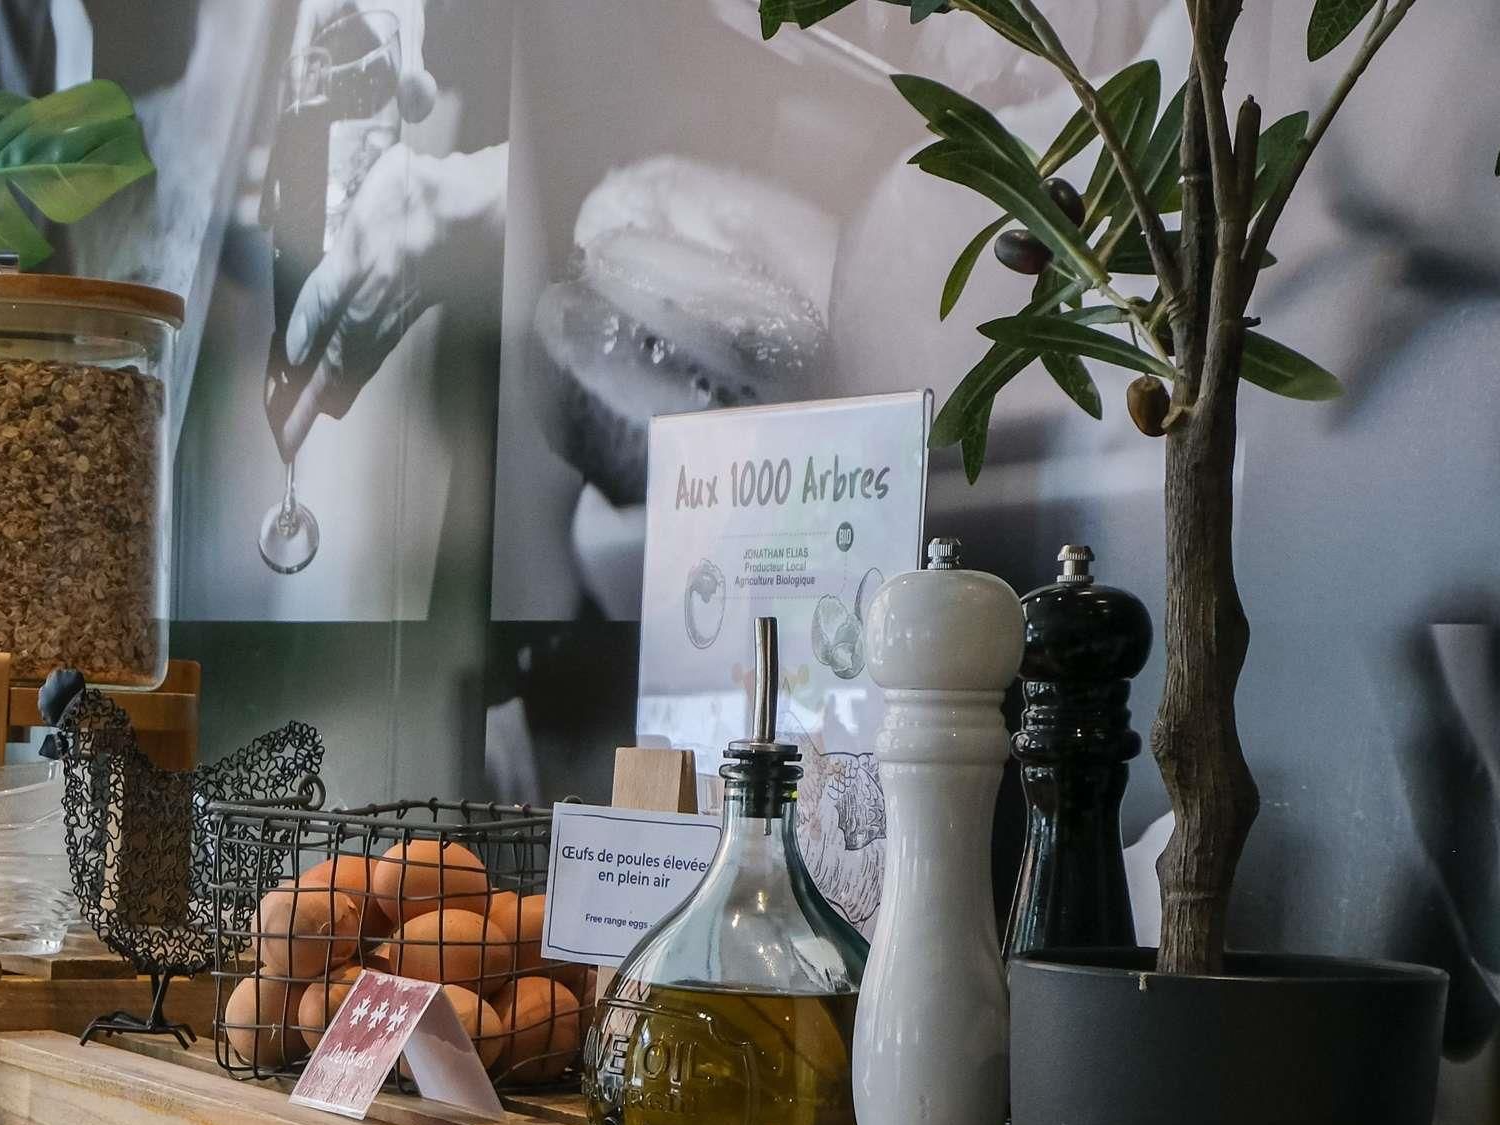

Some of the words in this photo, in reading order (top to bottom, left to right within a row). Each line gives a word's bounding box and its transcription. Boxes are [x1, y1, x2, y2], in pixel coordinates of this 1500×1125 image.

[675, 464, 718, 509] Aux
[731, 457, 792, 507] 1000
[802, 454, 891, 503] Arbres
[838, 528, 852, 545] BIO
[743, 548, 785, 560] JONATHAN
[786, 547, 809, 558] ELIAS
[744, 562, 784, 573] Producteur
[786, 559, 807, 571] Local
[734, 576, 774, 588] Agriculture
[776, 575, 816, 587] Biologique
[561, 845, 594, 862] Œufs
[597, 849, 614, 864] de
[616, 852, 661, 868] poules
[663, 855, 710, 872] élevée
[598, 870, 614, 883] en
[617, 870, 650, 887] plein
[653, 874, 671, 888] air
[585, 913, 603, 924] Free
[603, 916, 627, 928] range
[628, 920, 648, 930] eggs
